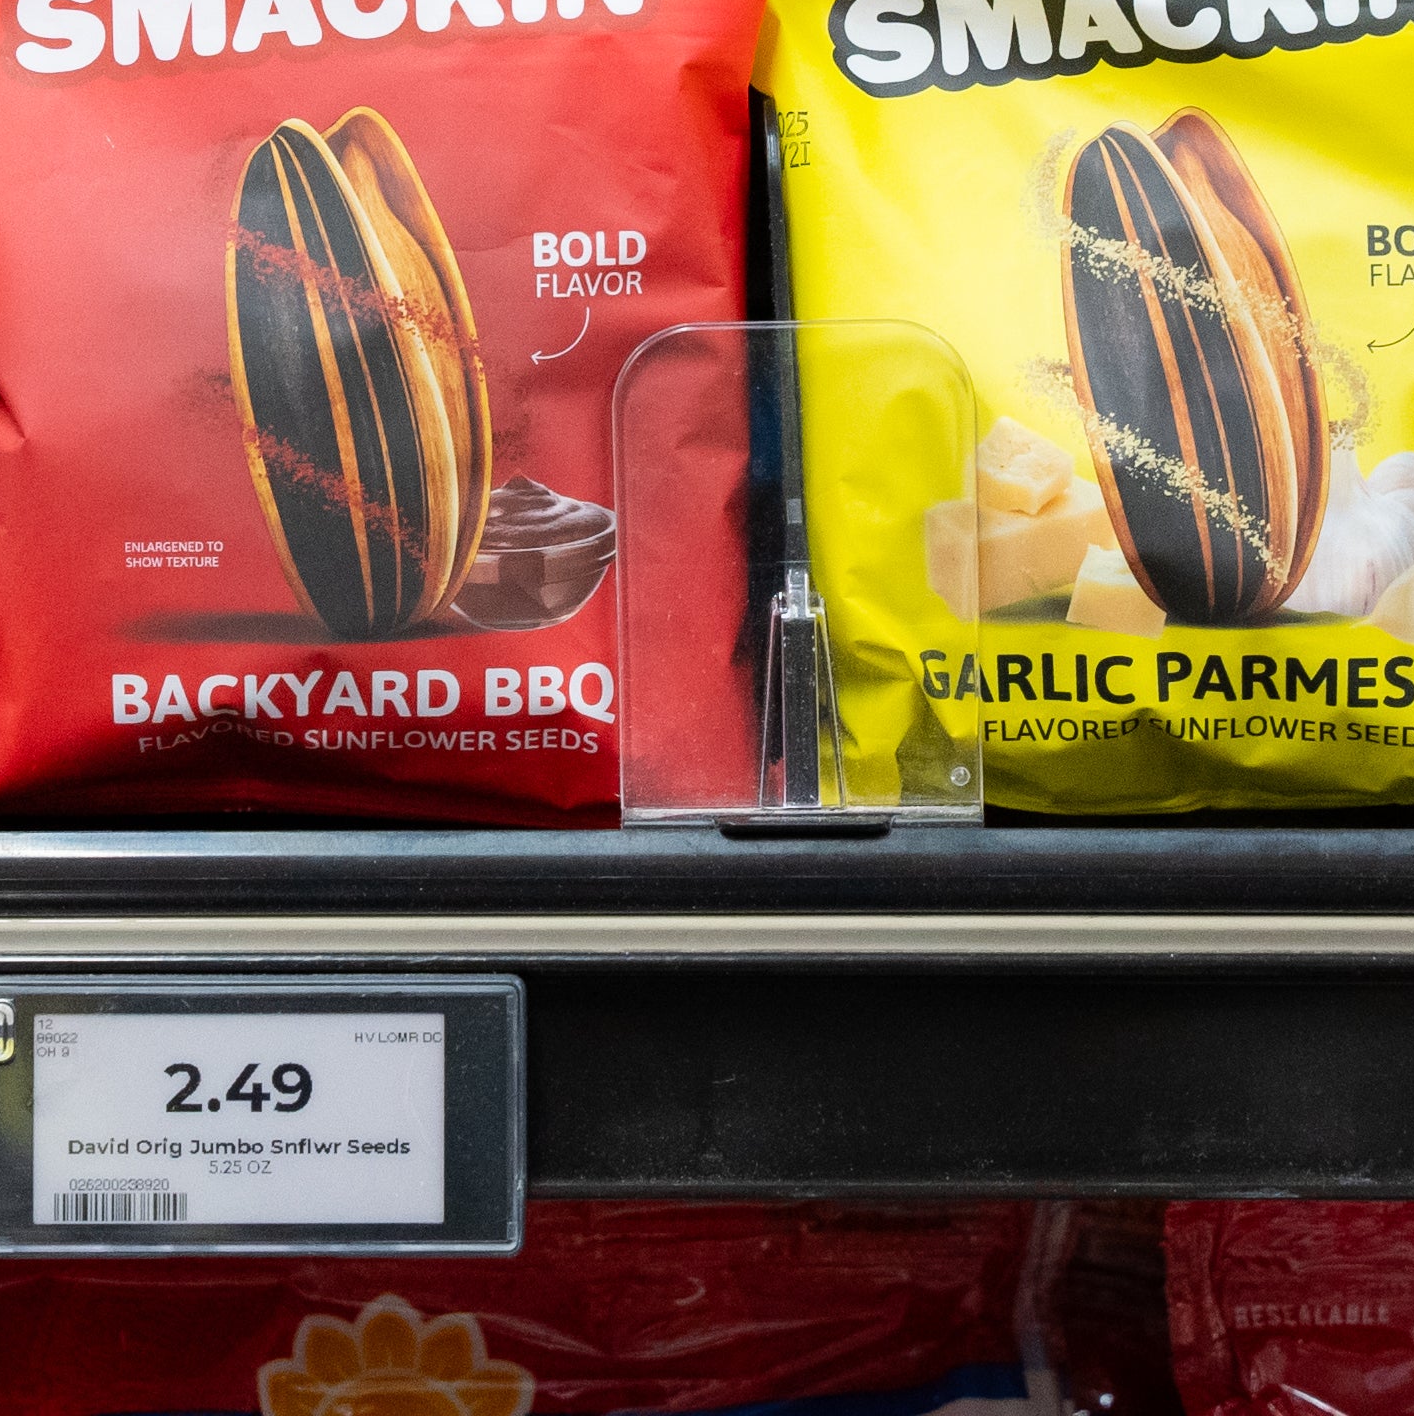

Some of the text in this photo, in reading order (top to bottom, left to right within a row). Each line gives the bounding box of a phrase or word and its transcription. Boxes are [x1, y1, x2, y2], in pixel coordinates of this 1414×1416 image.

[532, 230, 647, 268] BOLD
[535, 271, 644, 300] FLAVOR
[124, 540, 224, 553] ENLARGENED TO
[125, 556, 220, 568] SHOW TEXTURE
[919, 649, 1135, 706] GARLIC
[111, 661, 617, 725] BACKYARD BBQ
[136, 720, 600, 755] FLAVORED SUNFLOWER SEEDS
[983, 716, 1141, 744] FLAVORED
[1147, 713, 1338, 743] SUNFLOWER
[37, 1019, 54, 1031] 12
[354, 1032, 443, 1044] HV LOMR DC
[36, 1046, 57, 1058] OH
[163, 1062, 314, 1114] 2.49
[67, 1137, 411, 1159] David Orig Jumbo Snflwr Seeds
[208, 1160, 273, 1175] 5.25 OZ
